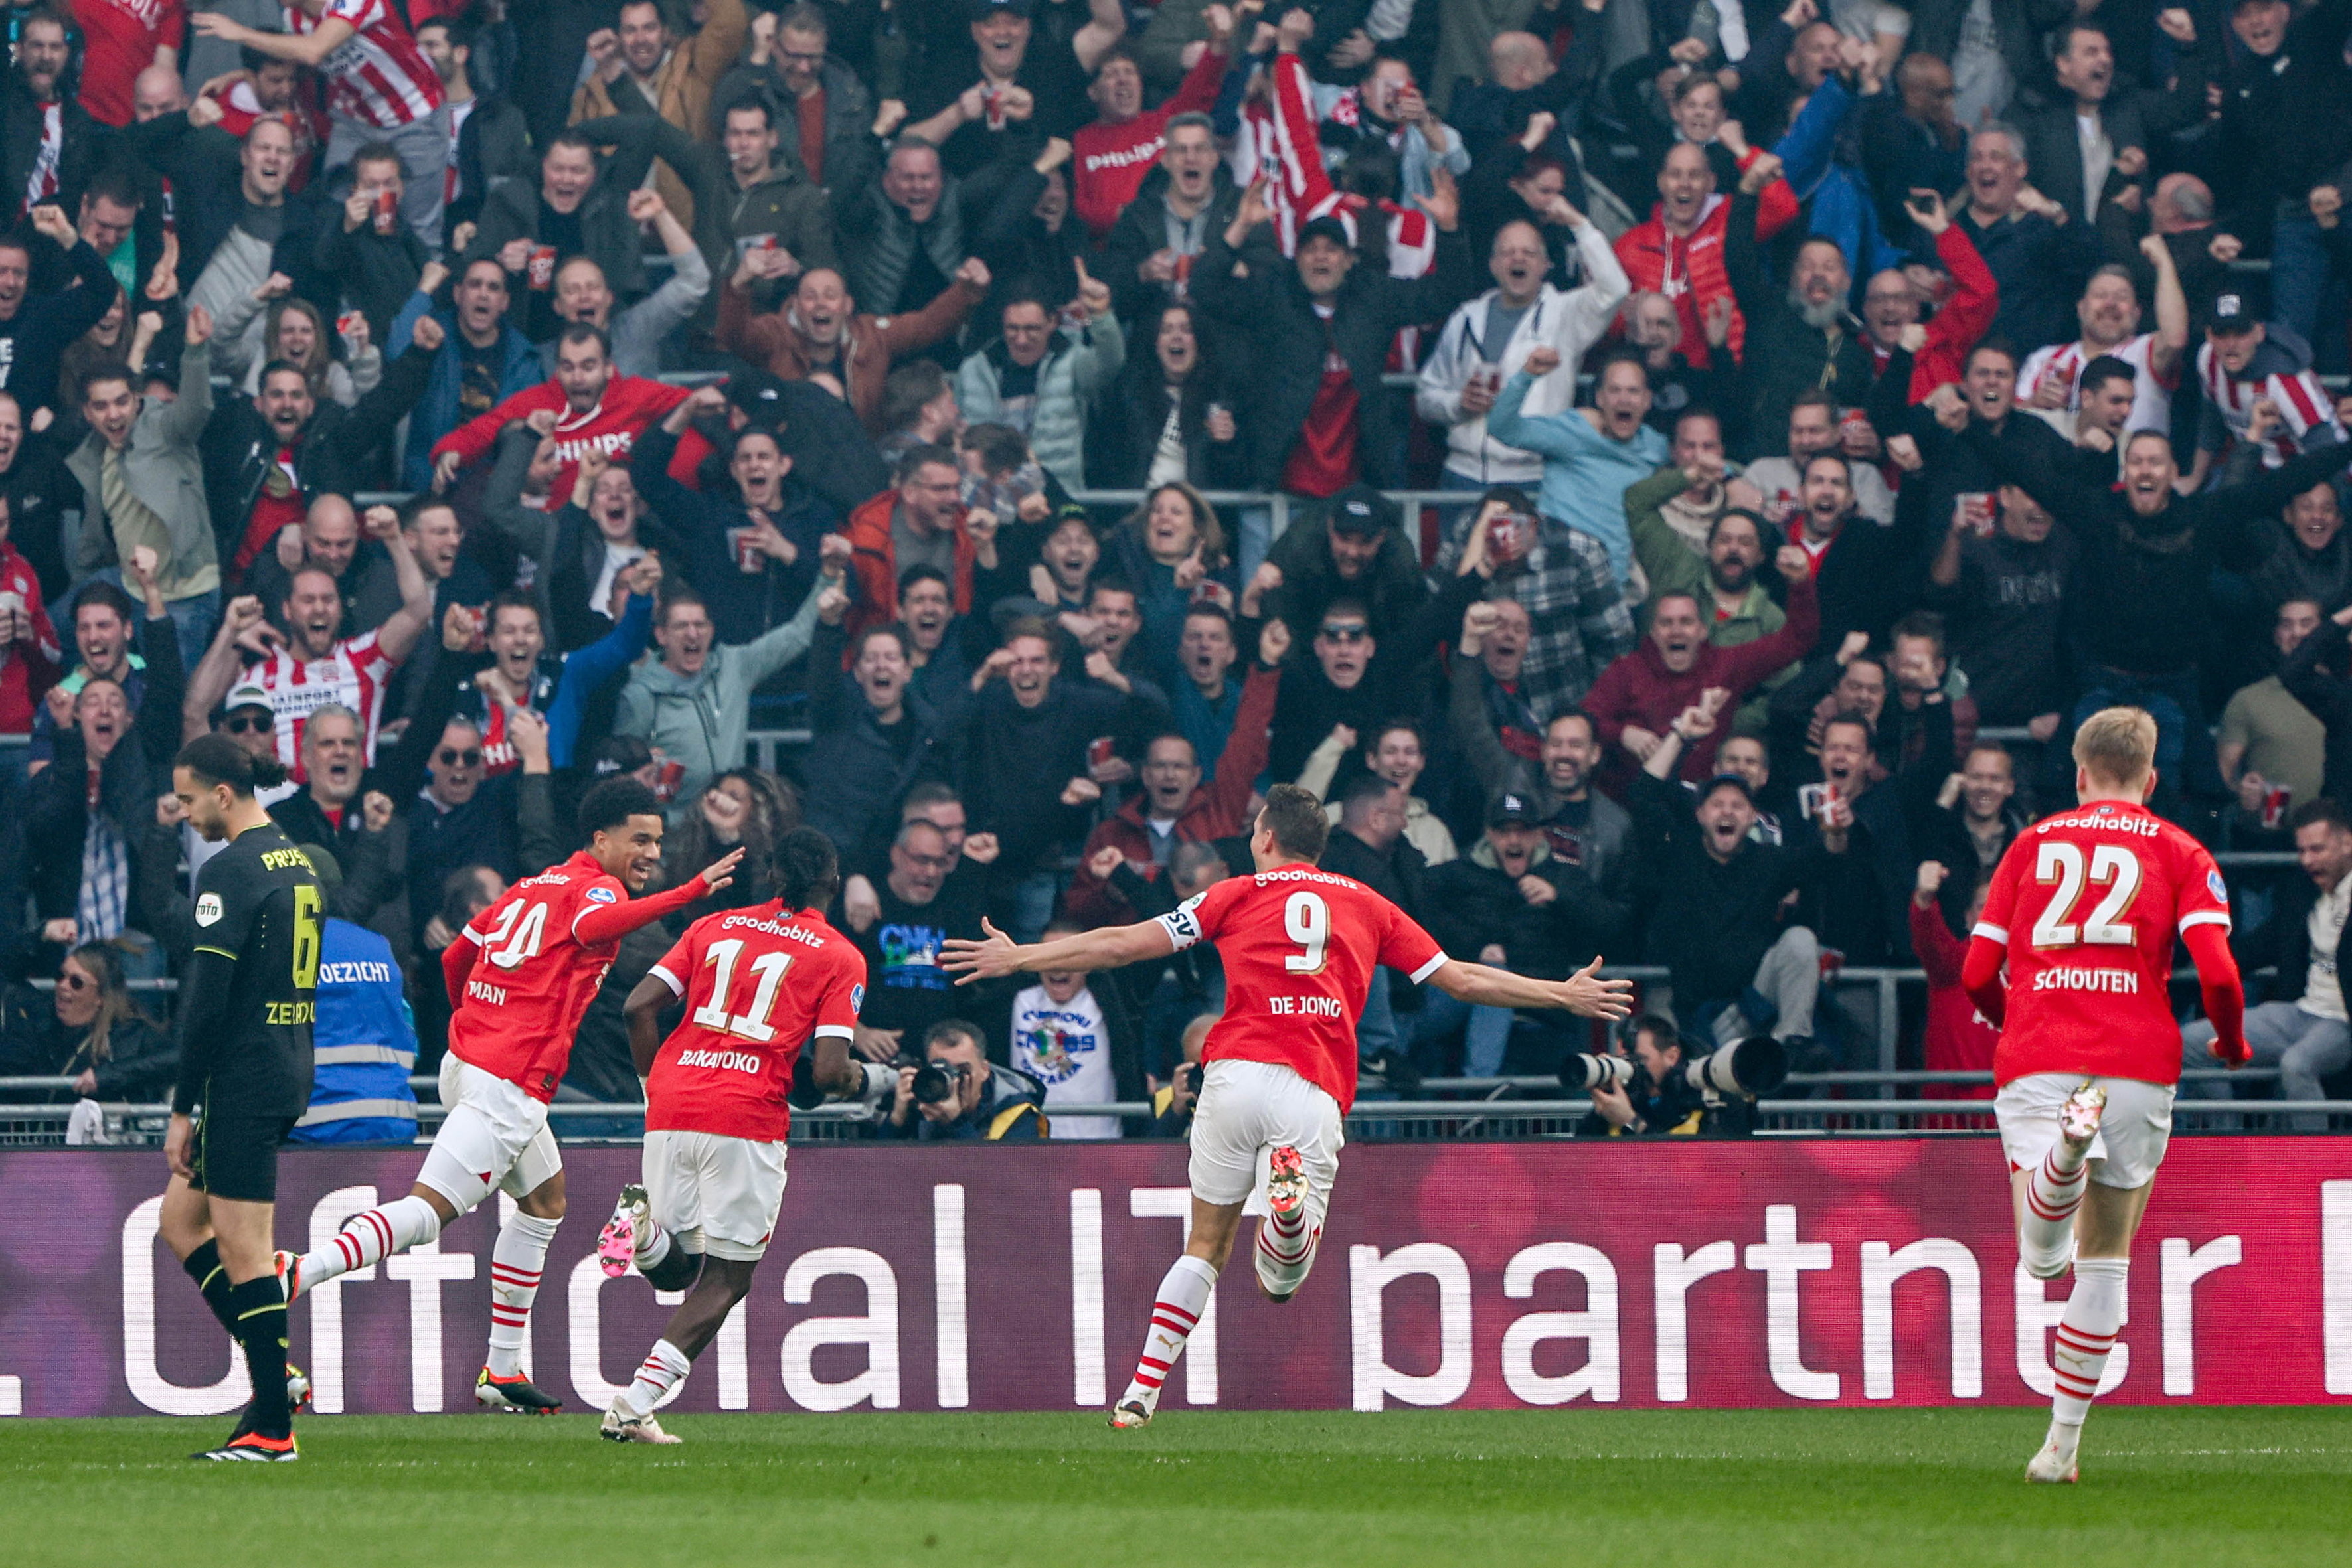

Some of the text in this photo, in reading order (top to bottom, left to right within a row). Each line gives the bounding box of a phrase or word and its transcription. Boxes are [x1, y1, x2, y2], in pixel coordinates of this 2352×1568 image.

[555, 431, 633, 461] HILIPS
[2036, 815, 2161, 837] goodhabitz
[1254, 870, 1359, 890] goodhabitz
[2032, 841, 2143, 951] 22
[197, 905, 218, 916] TOTO
[1168, 909, 1195, 937] SV
[293, 884, 321, 989] 6
[722, 915, 825, 949] goodhabitz
[1284, 891, 1331, 976] 9
[317, 961, 390, 984] OEZICHT
[2033, 967, 2138, 994] SCHOUTEN
[693, 939, 795, 1042] 11
[1269, 996, 1342, 1018] DE JONG
[677, 1049, 761, 1074] BAKAYOKO
